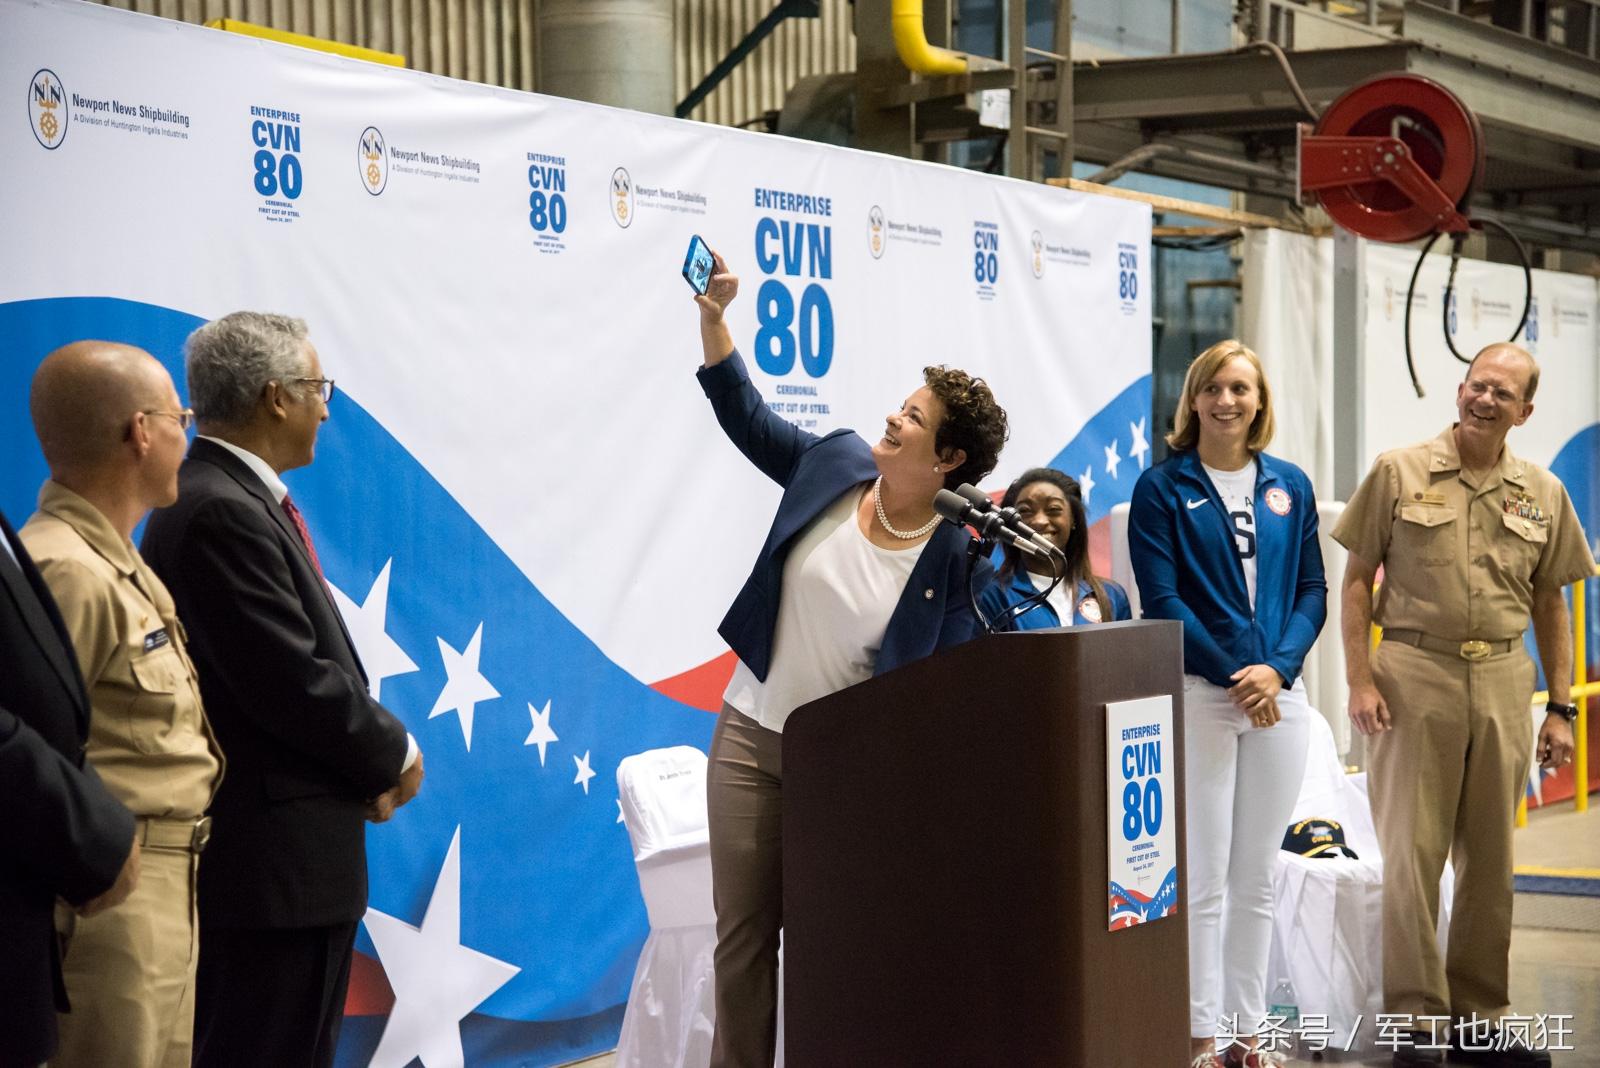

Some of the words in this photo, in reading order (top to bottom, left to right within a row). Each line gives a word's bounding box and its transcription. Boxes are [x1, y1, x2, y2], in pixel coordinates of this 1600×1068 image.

[72, 93, 110, 112] Newport
[112, 99, 137, 116] News
[139, 105, 190, 128] Shipbuilding
[250, 105, 301, 123] ENTERPRISE
[73, 113, 79, 121] A
[80, 113, 102, 125] Division
[103, 118, 110, 126] of
[110, 118, 141, 132] Huntington
[161, 127, 188, 139] Industries
[252, 119, 301, 153] CVN
[390, 146, 419, 163] Newport
[420, 151, 440, 165] News
[440, 154, 480, 174] Shipbuilding
[526, 152, 566, 166] ENTERPRISE
[253, 149, 303, 200] 80
[528, 164, 566, 193] CVN
[258, 207, 271, 215] FIRST
[529, 190, 567, 234] 80
[754, 187, 832, 217] ENTERPRISE
[755, 216, 832, 280] CVN
[974, 230, 998, 252] CVN
[974, 250, 998, 284] 80
[1119, 270, 1137, 300] 80
[753, 278, 835, 379] 80
[776, 384, 818, 397] CEREMONIAL
[786, 402, 798, 413] CUT
[800, 403, 808, 413] OF
[809, 403, 830, 415] STEEL
[1121, 723, 1161, 741] ENTERPRISE
[1121, 740, 1162, 780] CVN
[1122, 777, 1163, 842] 80
